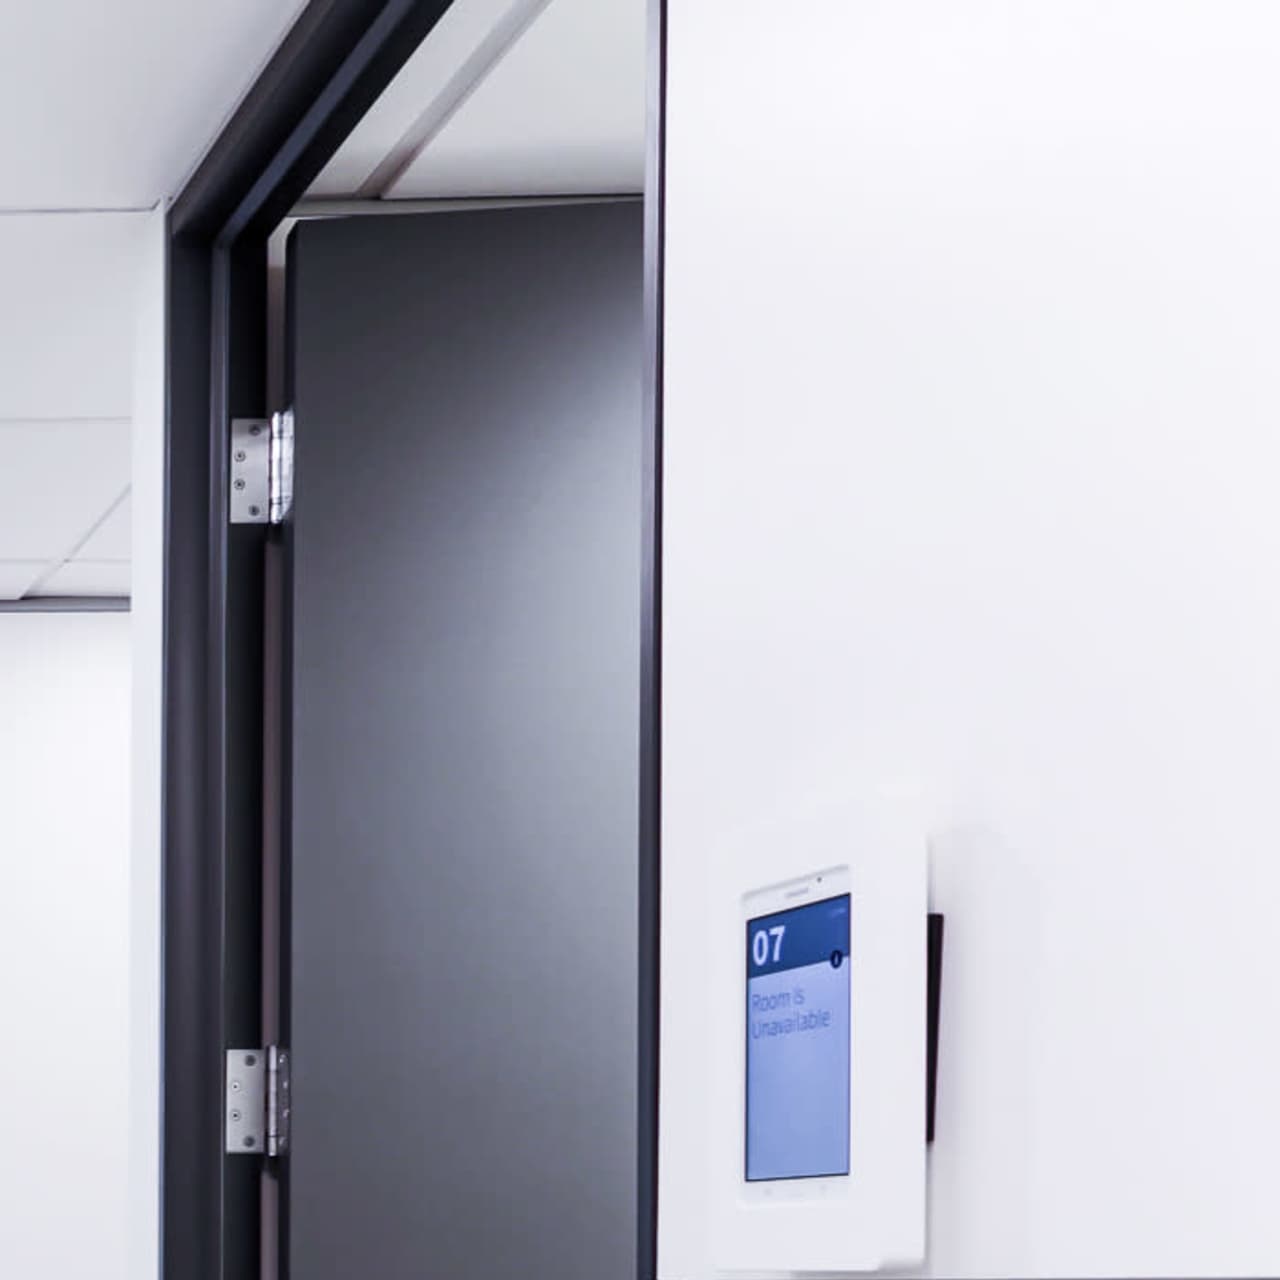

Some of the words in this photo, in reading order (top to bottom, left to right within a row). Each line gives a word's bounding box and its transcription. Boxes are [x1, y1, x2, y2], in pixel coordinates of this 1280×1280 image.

[752, 925, 785, 966] 07
[752, 991, 791, 1012] Room
[752, 1009, 831, 1039] Unavailable
